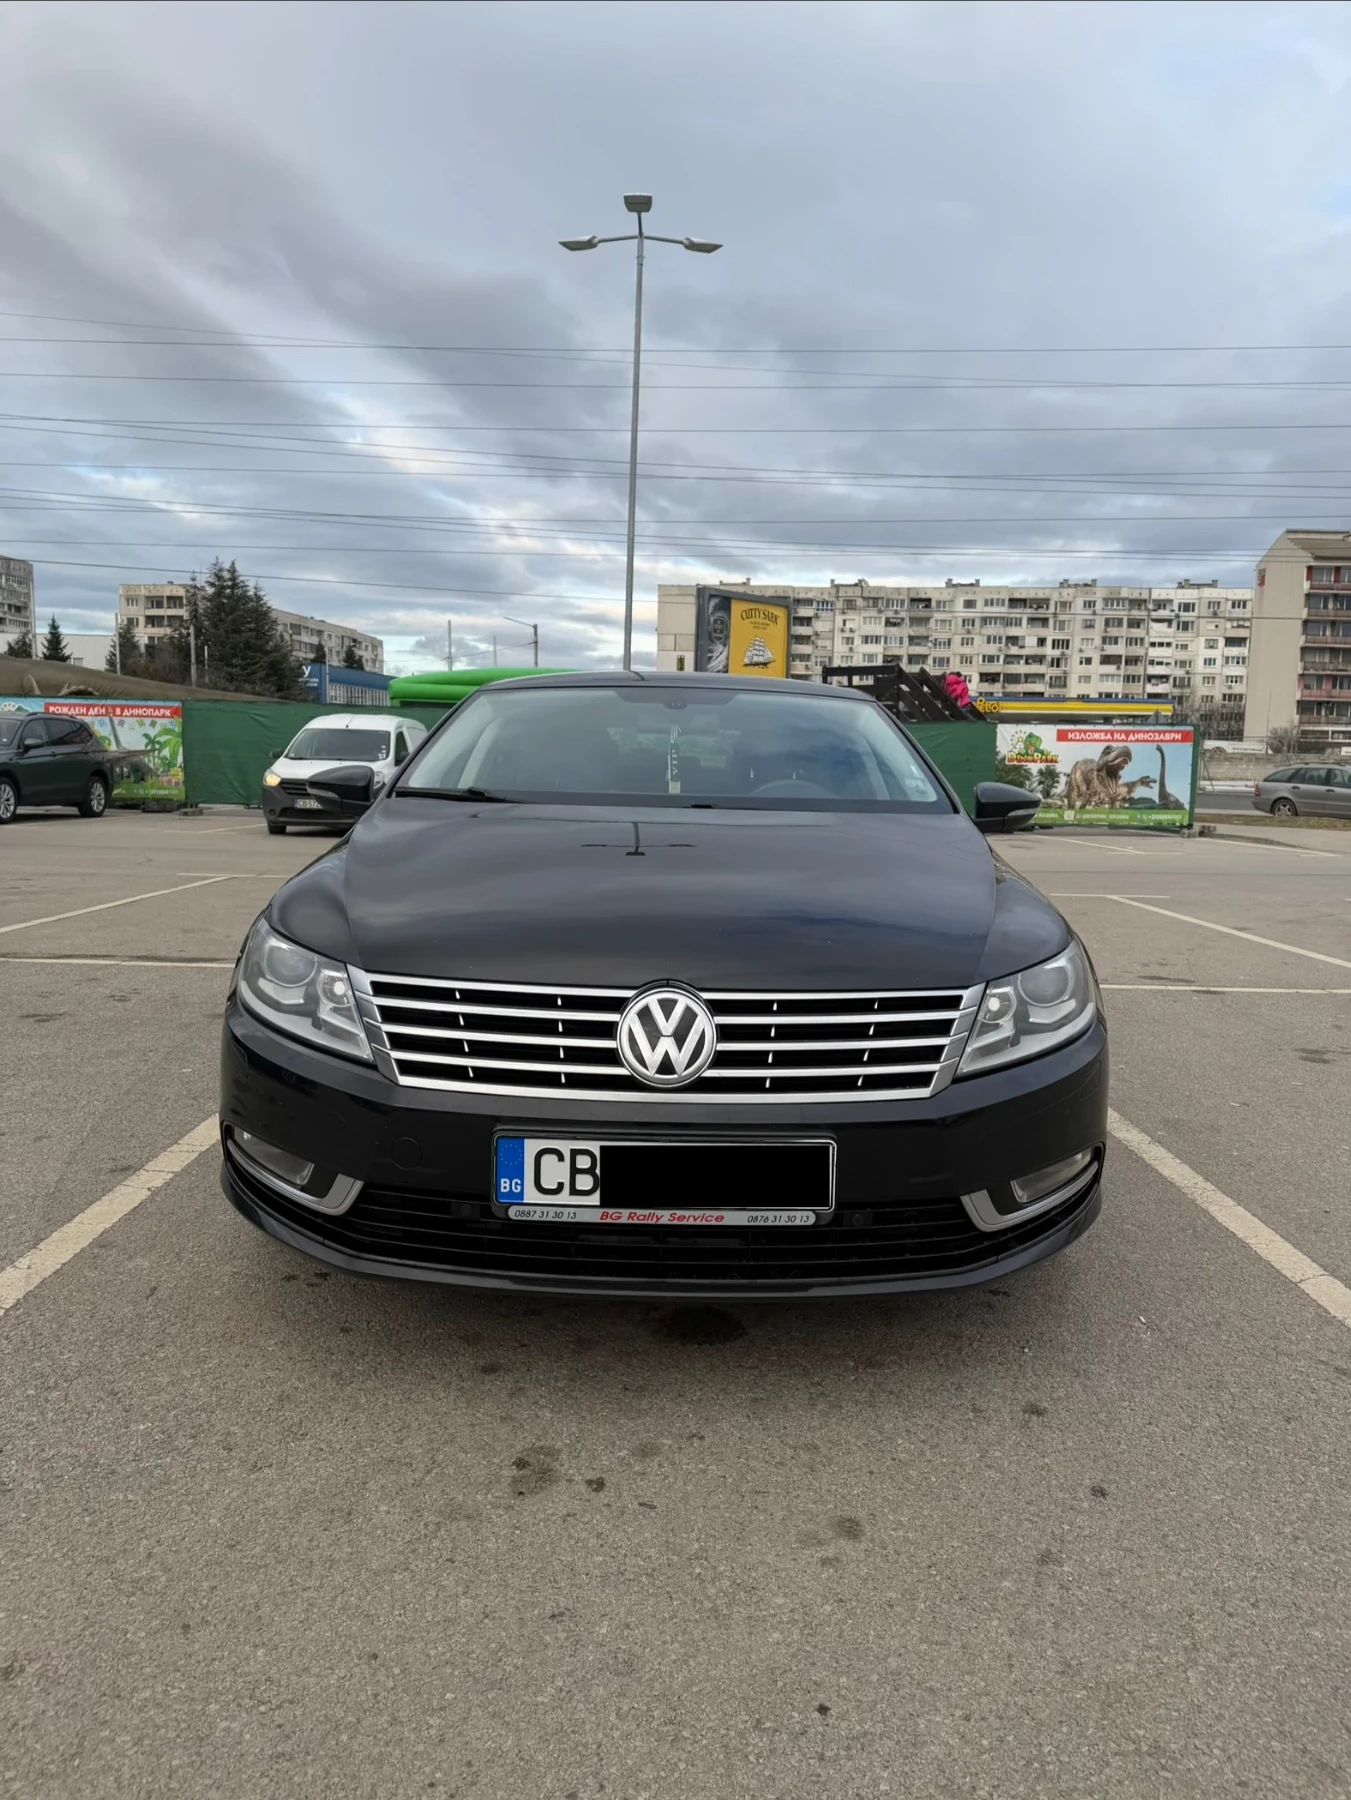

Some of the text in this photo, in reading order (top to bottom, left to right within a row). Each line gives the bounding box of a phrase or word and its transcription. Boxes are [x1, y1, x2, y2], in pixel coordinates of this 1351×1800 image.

[49, 705, 172, 717] РОЖДЕН ДЕН В ДИНОПАРК
[1067, 731, 1183, 742] ИЗЛОЖБА НА ДИНОЗАВРИ
[533, 1146, 600, 1197] CB
[500, 1178, 522, 1193] BG
[514, 1209, 577, 1220] 0887 31 30 13
[600, 1211, 725, 1224] BG Rally Service
[747, 1215, 810, 1223] 0876 31 30 13
